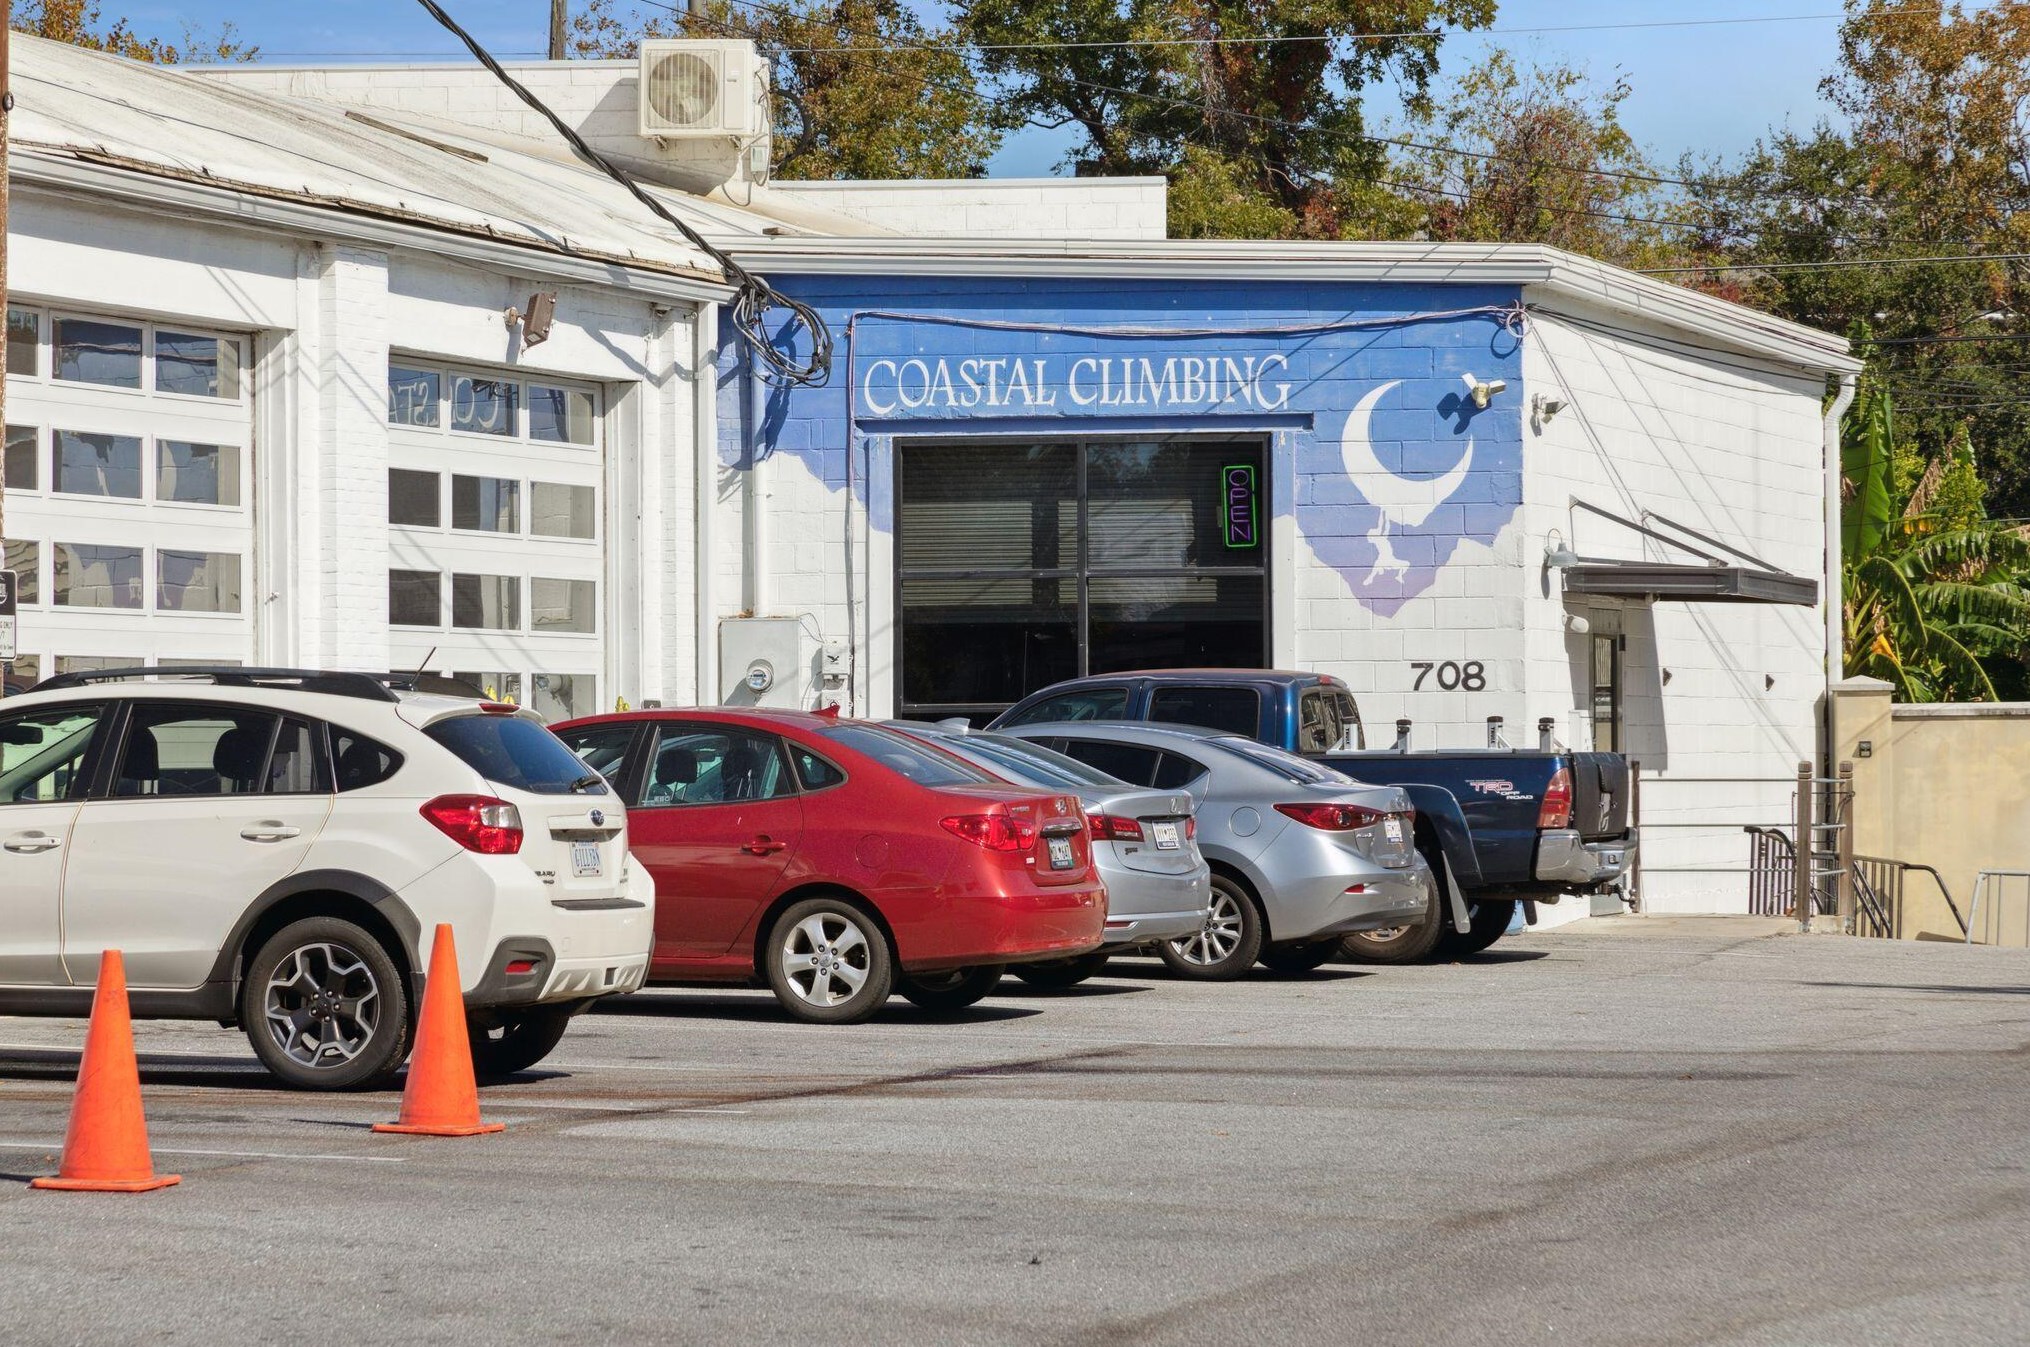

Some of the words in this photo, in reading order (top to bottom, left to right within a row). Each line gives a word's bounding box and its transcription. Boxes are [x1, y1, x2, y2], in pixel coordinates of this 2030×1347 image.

[864, 357, 1057, 414] COASTAL
[1069, 354, 1292, 410] CLIMBING
[1229, 469, 1251, 542] OPEN
[1411, 661, 1486, 691] 708
[1468, 780, 1513, 794] TRD
